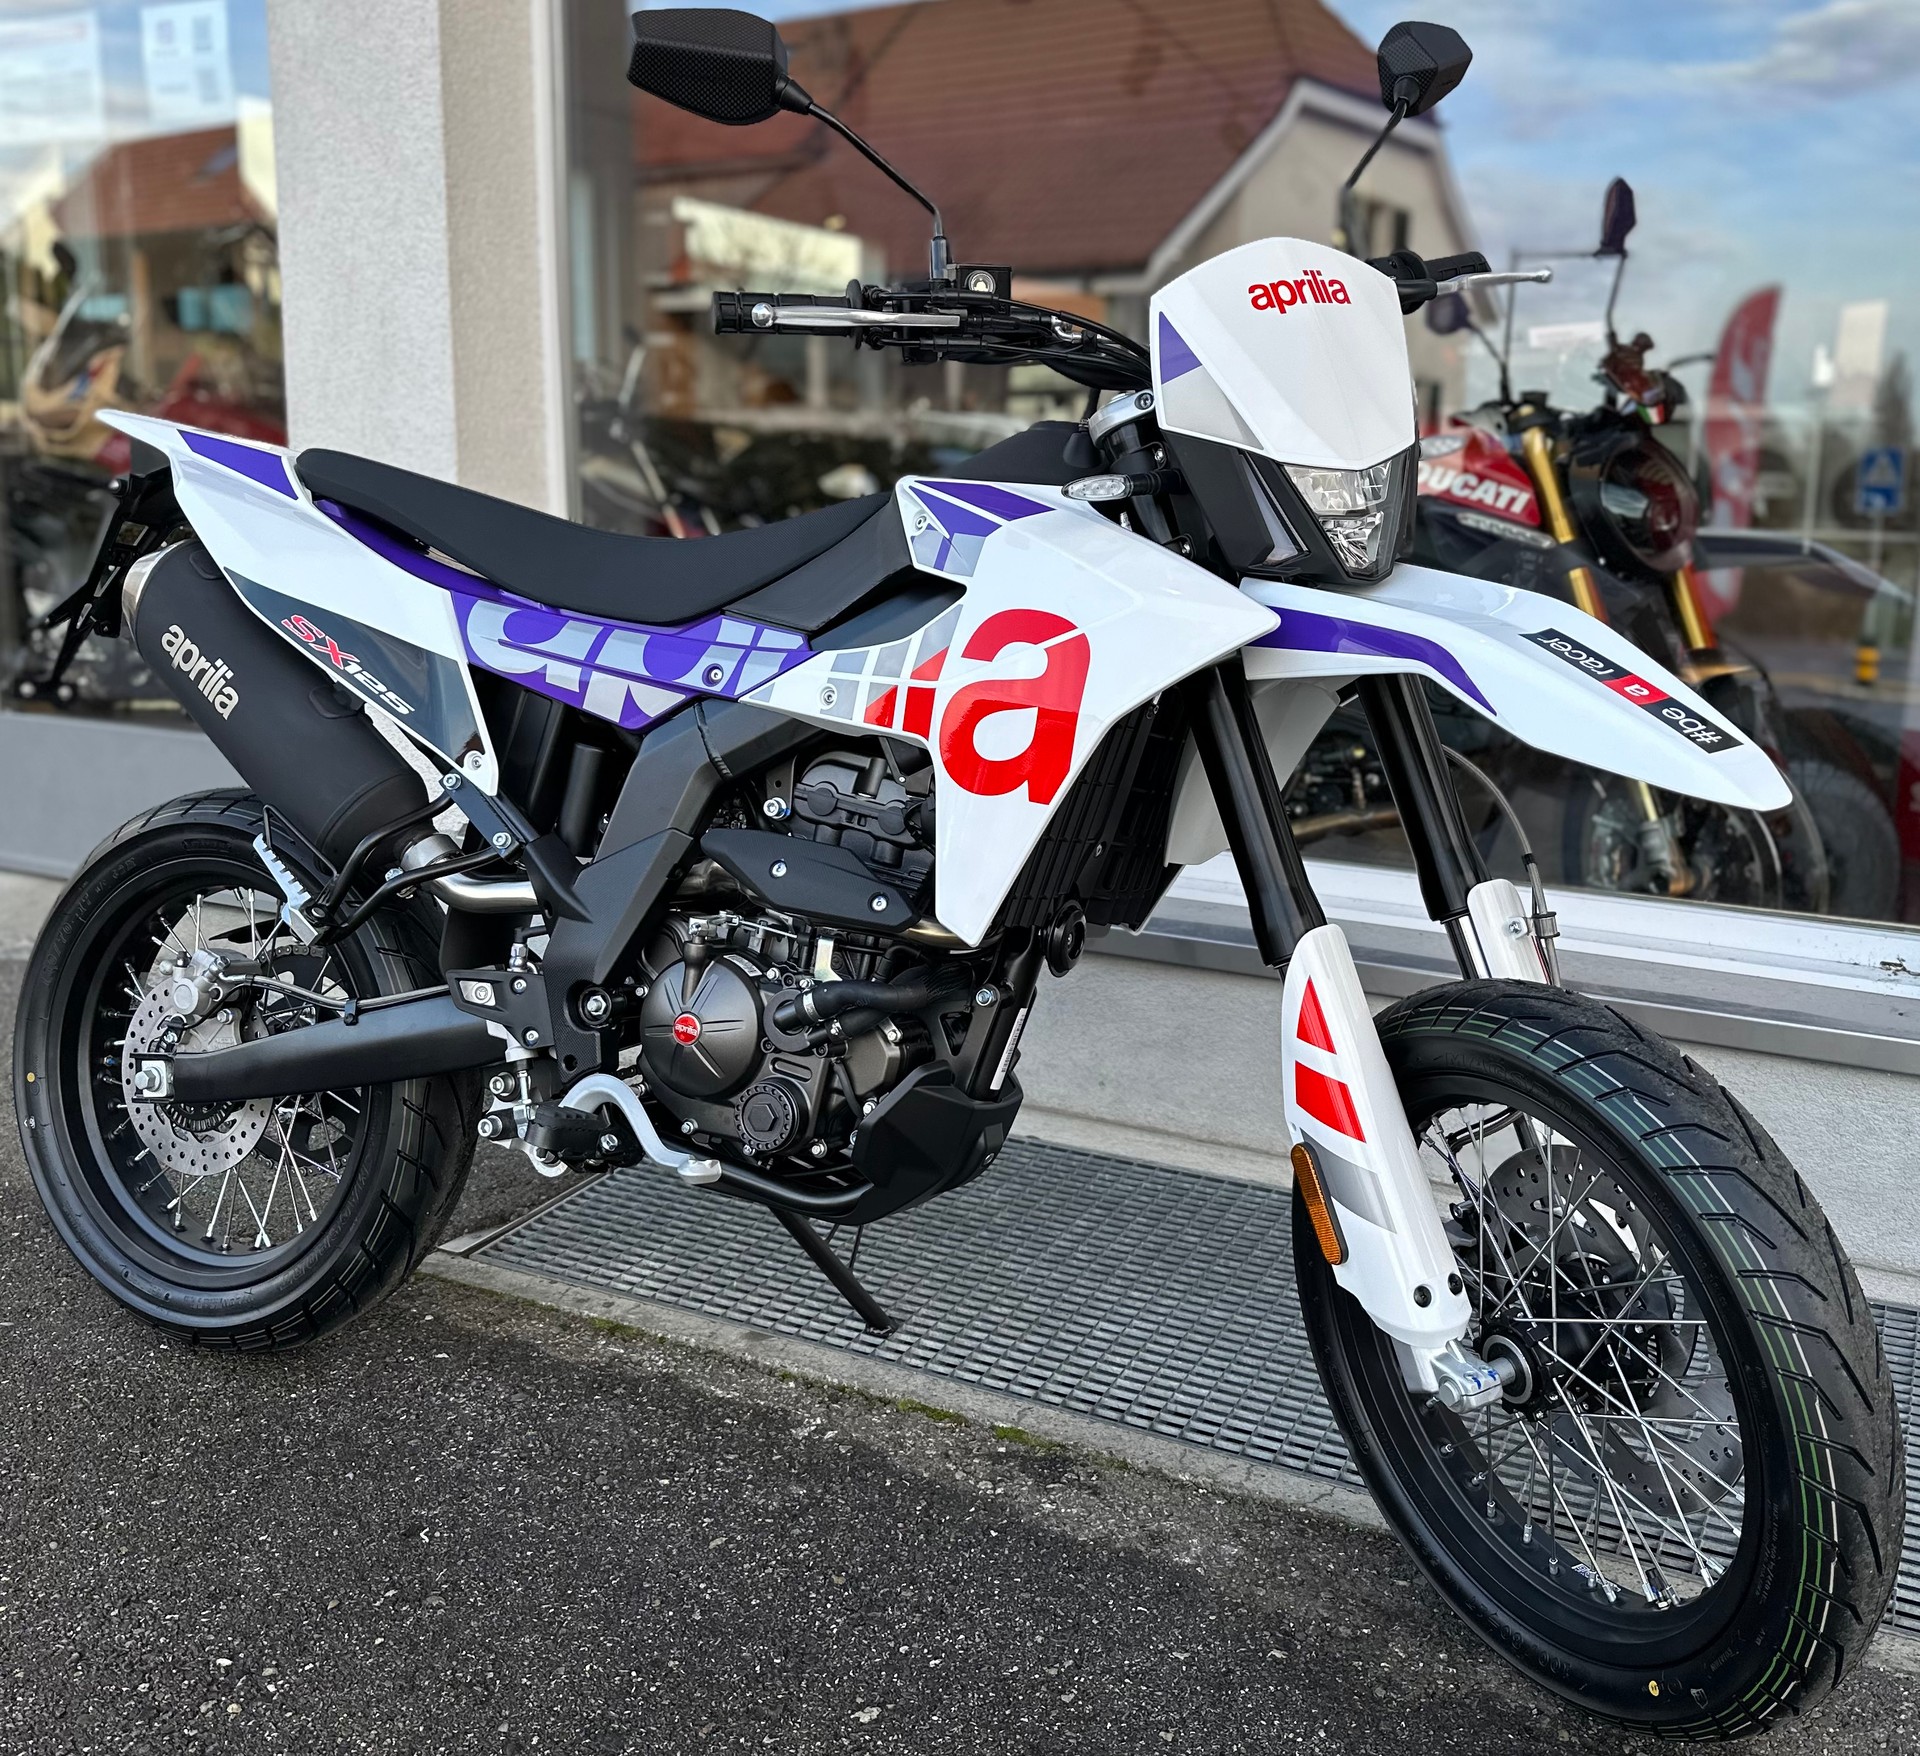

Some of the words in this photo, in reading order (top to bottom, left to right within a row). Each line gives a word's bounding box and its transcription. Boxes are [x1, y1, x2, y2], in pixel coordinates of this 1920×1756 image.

[1248, 269, 1352, 314] aprilia
[161, 624, 239, 720] aprilia
[1537, 637, 1615, 675] racer
[1623, 683, 1650, 697] a
[1662, 707, 1723, 744] #be
[674, 1023, 698, 1036] aprilia
